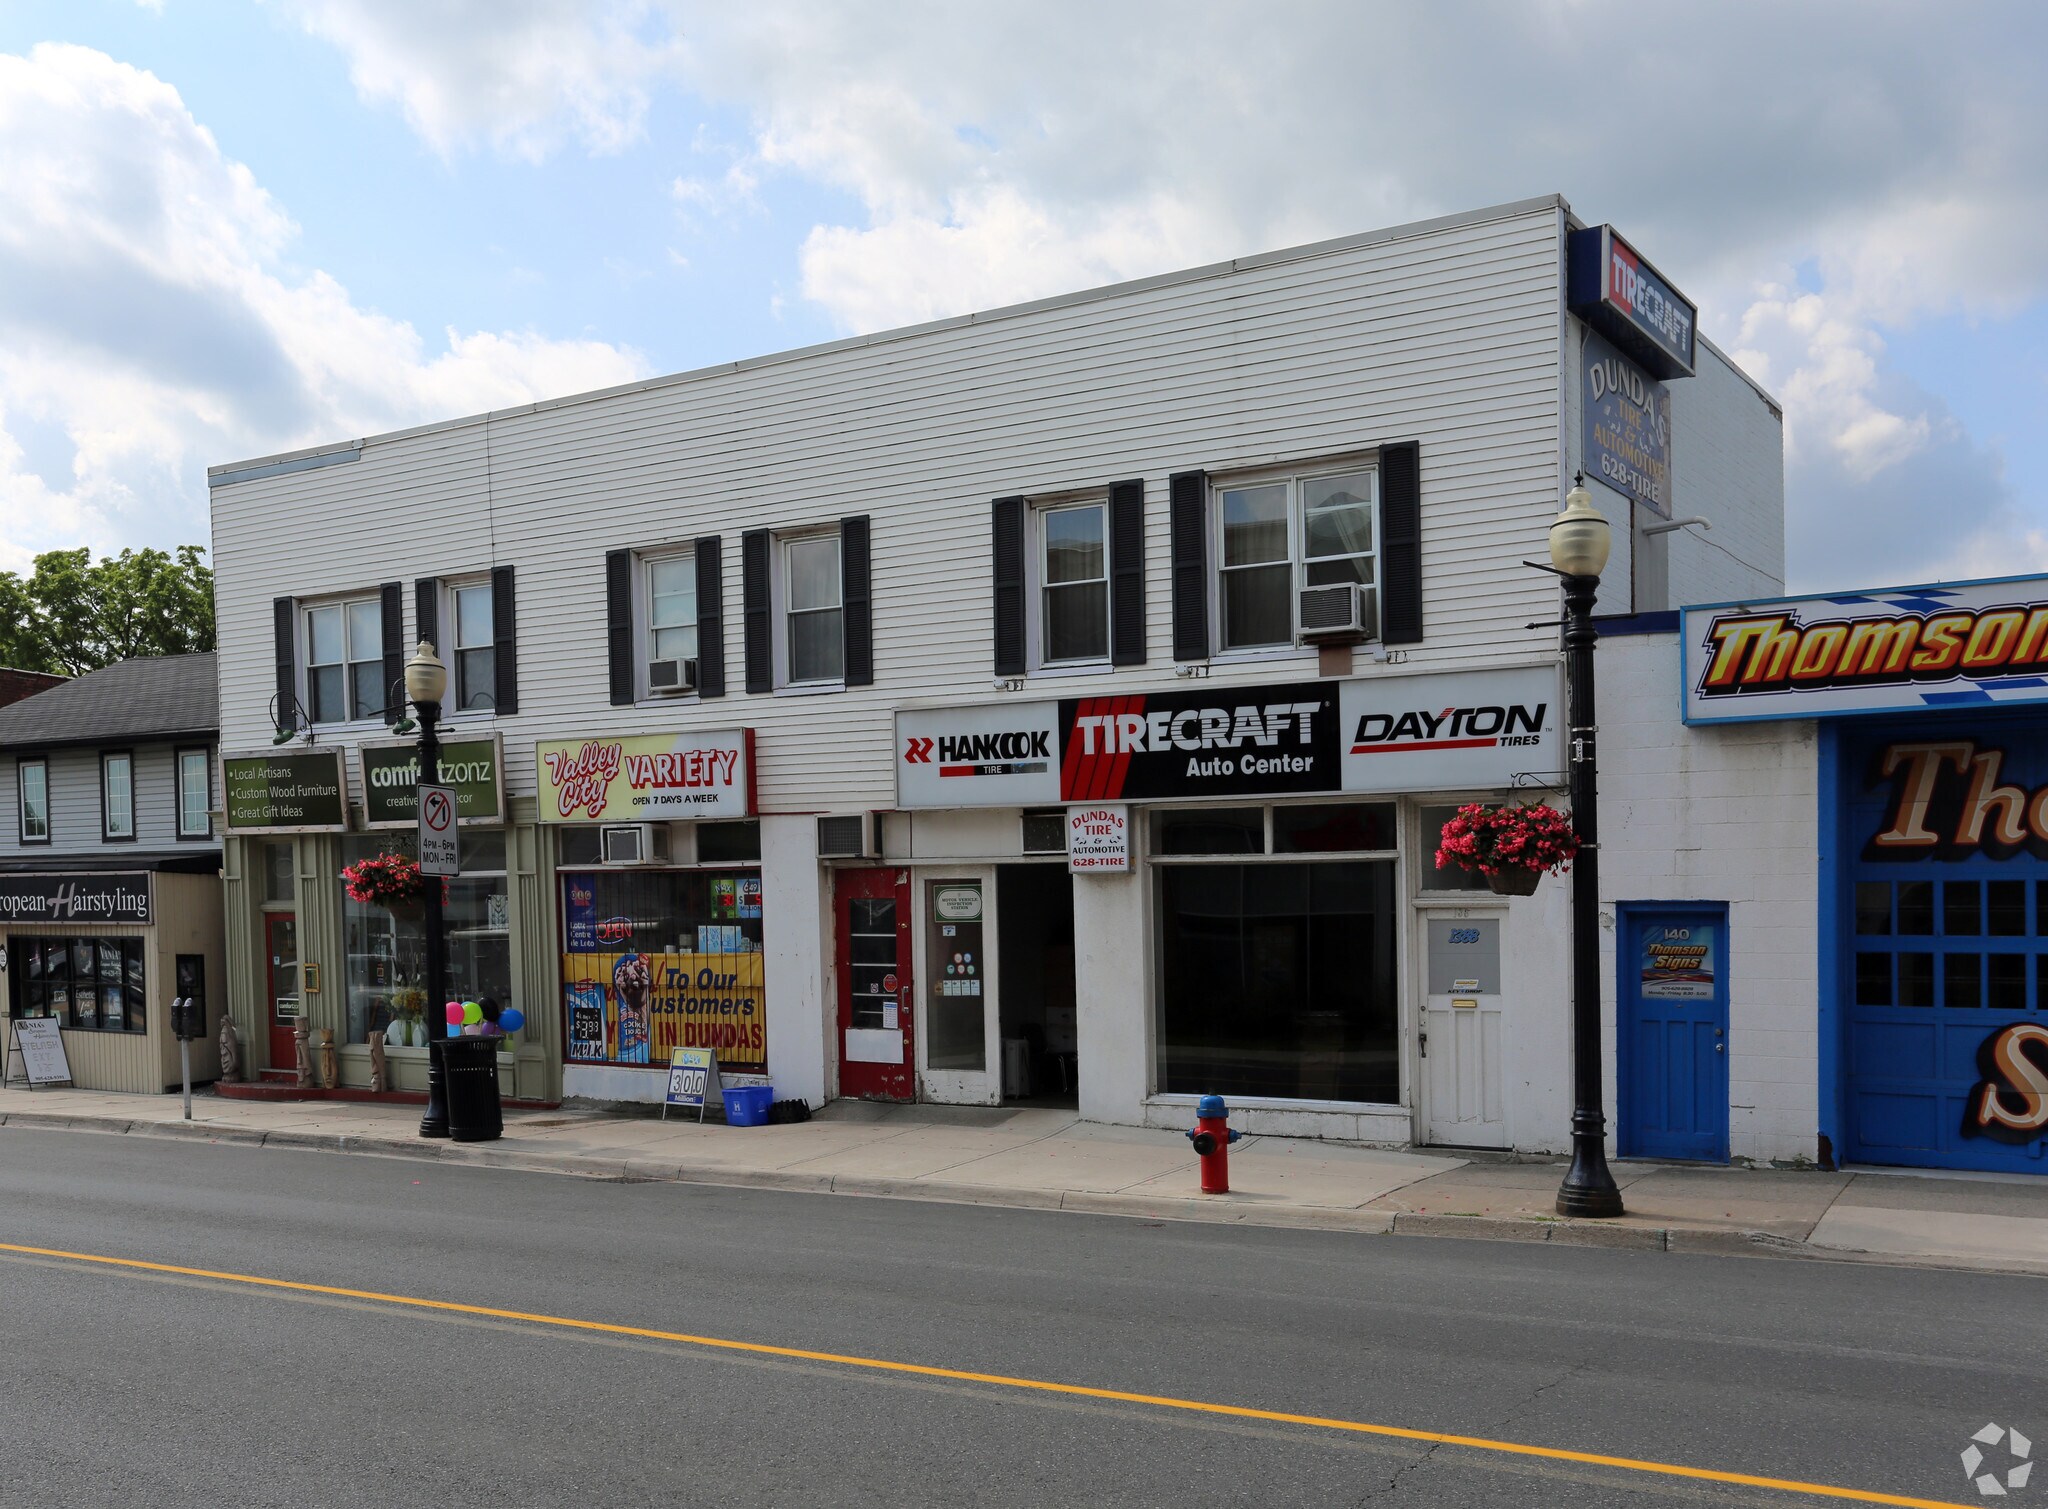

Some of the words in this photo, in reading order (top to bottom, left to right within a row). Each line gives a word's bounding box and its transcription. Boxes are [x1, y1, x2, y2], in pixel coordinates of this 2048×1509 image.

[1612, 253, 1690, 352] TIRECRAFT
[1590, 358, 1667, 447] DUNDAS
[1618, 399, 1642, 430] TIRE
[1594, 423, 1665, 482] AUTOMOTIVE
[1601, 453, 1660, 505] 628-TIRE
[1699, 605, 2048, 692] Thomson
[1076, 701, 1322, 755] TIRECRAFT
[1354, 703, 1547, 743] DAYTON
[938, 730, 1051, 762] HANKOOK
[1499, 735, 1540, 747] TIRES
[234, 768, 256, 780] Local
[258, 766, 292, 779] Artisans
[370, 757, 491, 787] comftzonz
[544, 741, 622, 786] Valley
[624, 749, 738, 789] VARIETY
[983, 766, 1002, 774] TIRE
[1186, 757, 1234, 777] Auto
[1240, 754, 1314, 775] Center
[236, 787, 268, 799] Custom
[269, 785, 295, 798] Wood
[298, 784, 337, 797] Furniture
[558, 775, 608, 818] City
[632, 797, 650, 805] OPEN
[653, 796, 659, 804] 7
[661, 795, 682, 804] DAYS
[684, 795, 691, 803] A
[692, 794, 718, 803] WEEK
[386, 795, 418, 807] creative
[237, 806, 260, 819] Great
[262, 805, 278, 818] Gift
[281, 805, 303, 817] Ideas
[1072, 811, 1124, 829] DUNDAS
[1084, 825, 1112, 835] TIRE
[423, 838, 437, 850] 4PM
[442, 839, 455, 851] 6PM
[1072, 846, 1125, 854] AUTOMOTIVE
[423, 852, 440, 863] MON
[445, 853, 456, 864] FRI
[1073, 857, 1125, 866] 628-TIRE
[46, 882, 147, 918] Hairstyling
[596, 922, 633, 939] OPEN
[1664, 929, 1690, 940] 140
[1648, 943, 1708, 956] Thomson
[1654, 955, 1702, 971] Signs
[666, 968, 690, 990] To
[697, 968, 738, 990] Our
[659, 1022, 677, 1047] IN
[685, 1022, 763, 1049] DUNDAS
